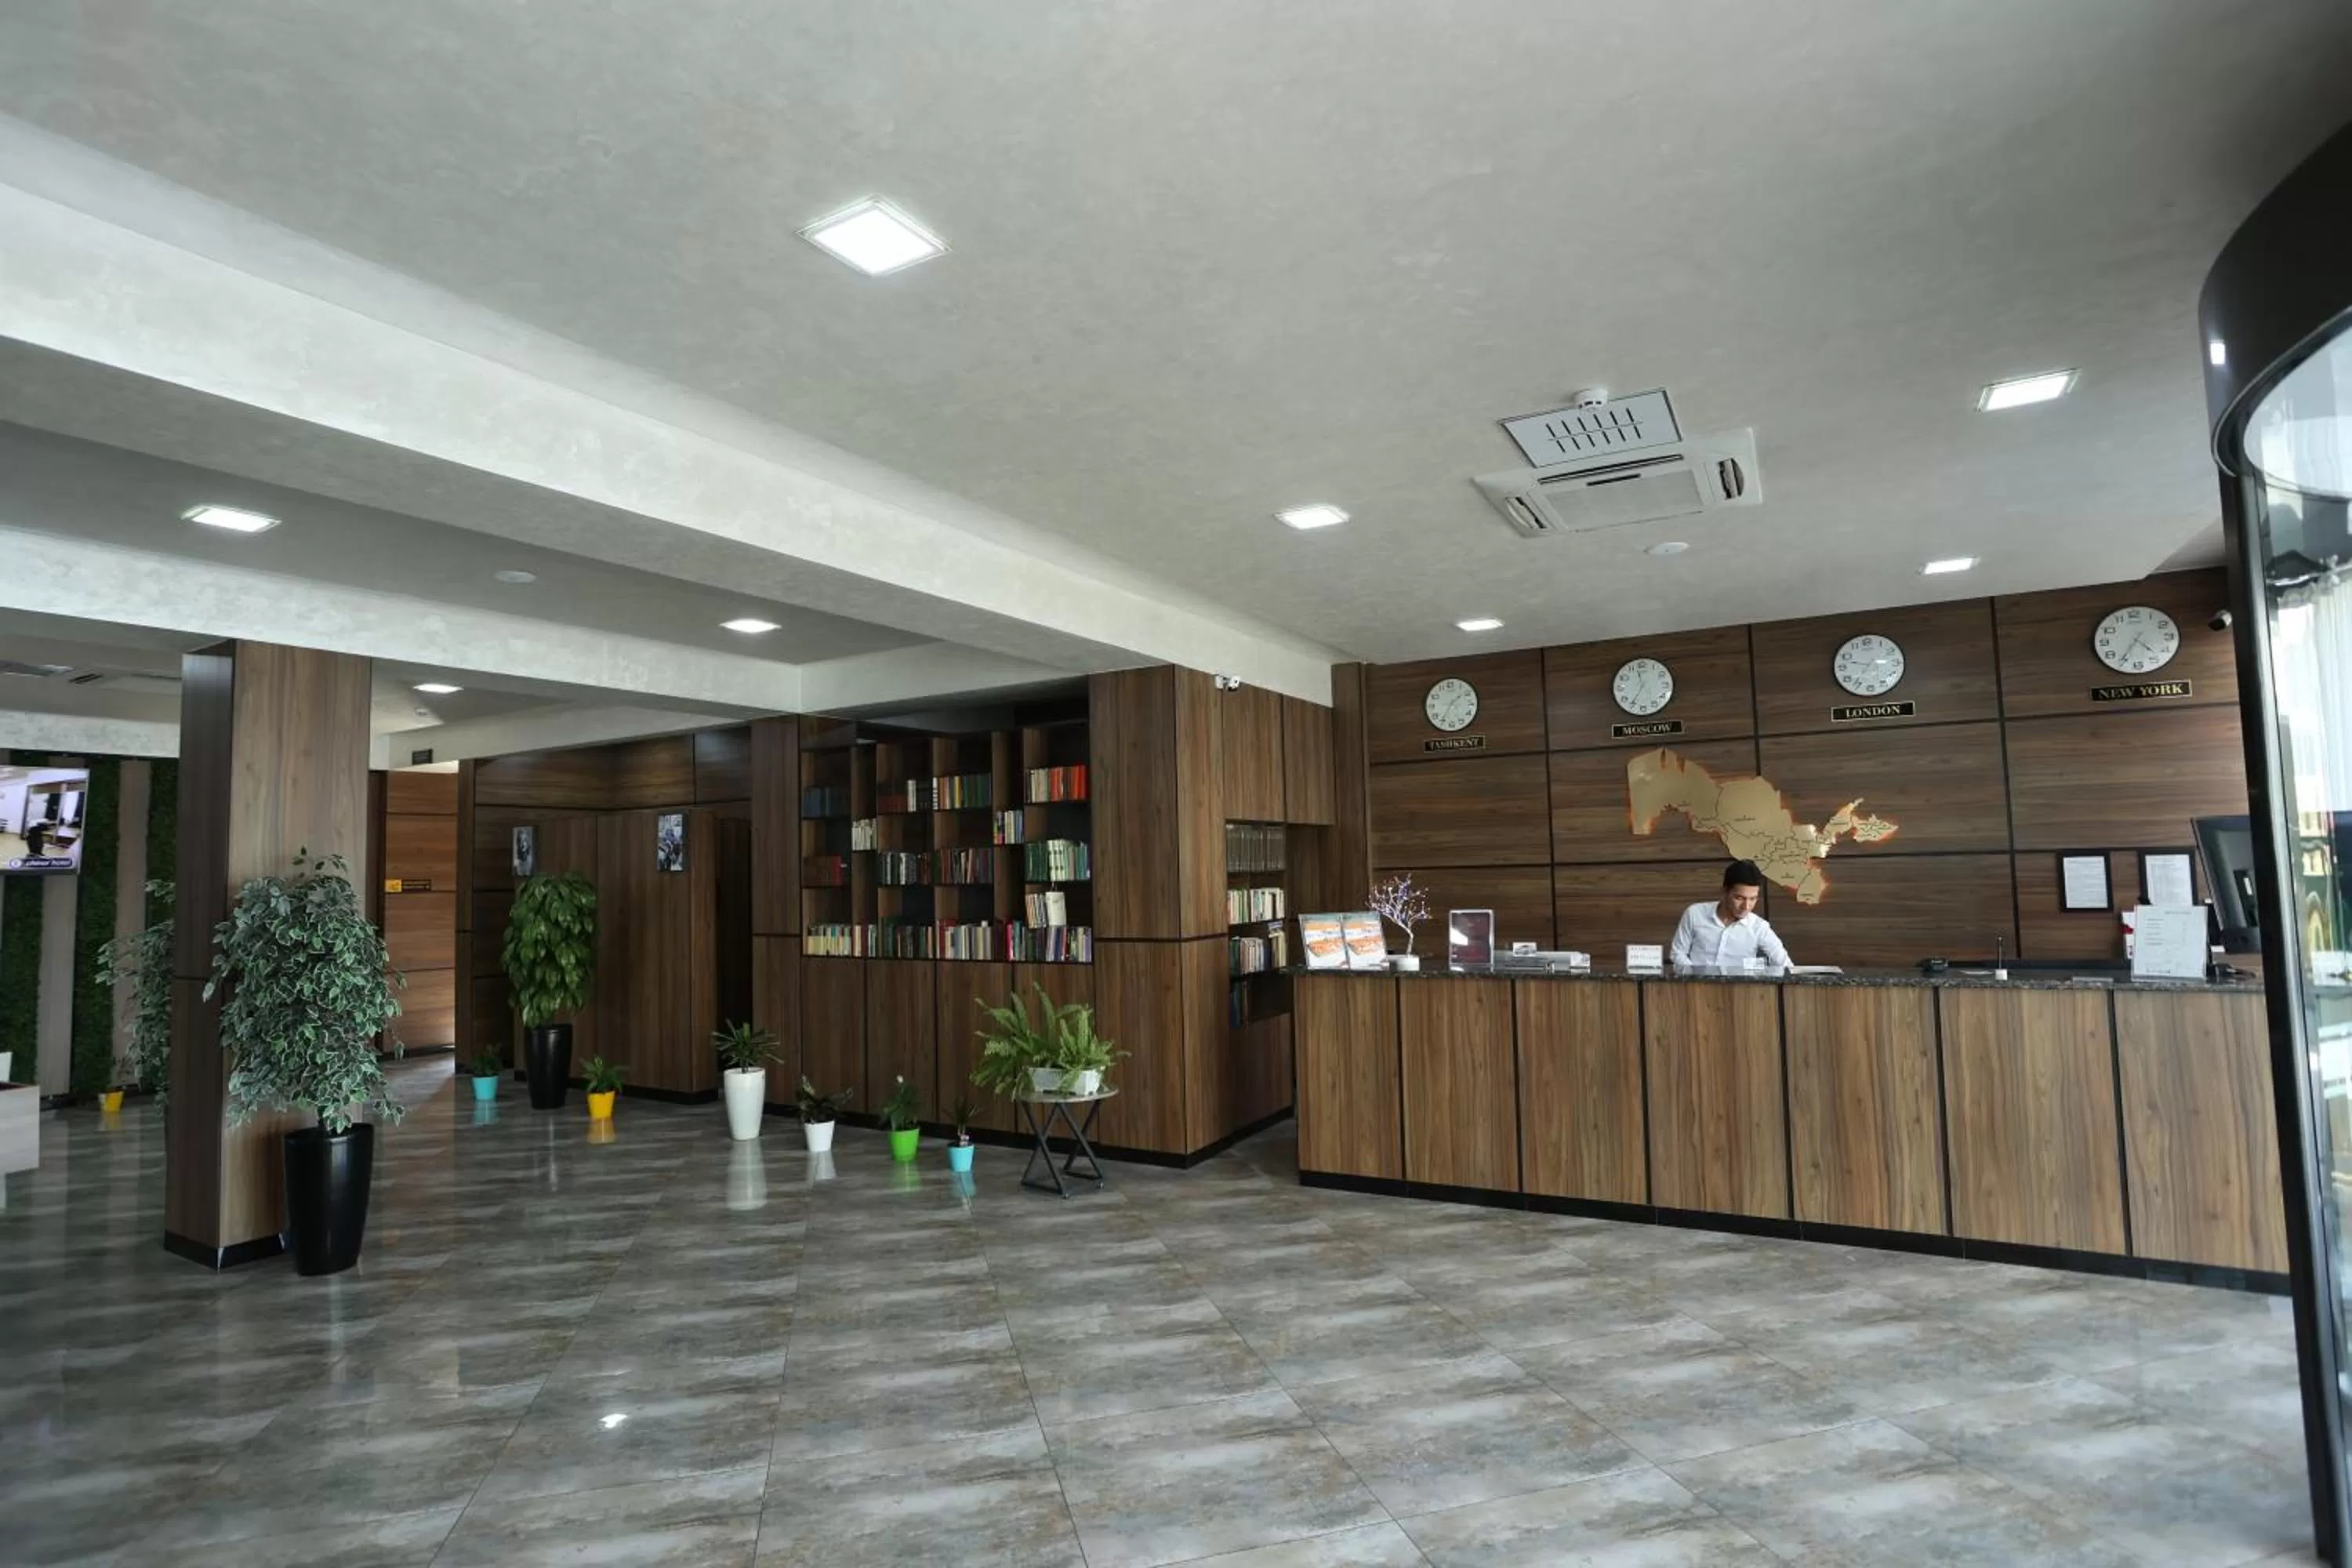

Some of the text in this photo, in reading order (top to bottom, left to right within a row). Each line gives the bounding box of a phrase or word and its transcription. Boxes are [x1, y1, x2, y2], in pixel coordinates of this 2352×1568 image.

[2099, 684, 2183, 699] NEW YORK
[1846, 706, 1900, 718] LONDON
[1623, 723, 1671, 735] MOSCOW
[1430, 739, 1480, 750] TASHKENT
